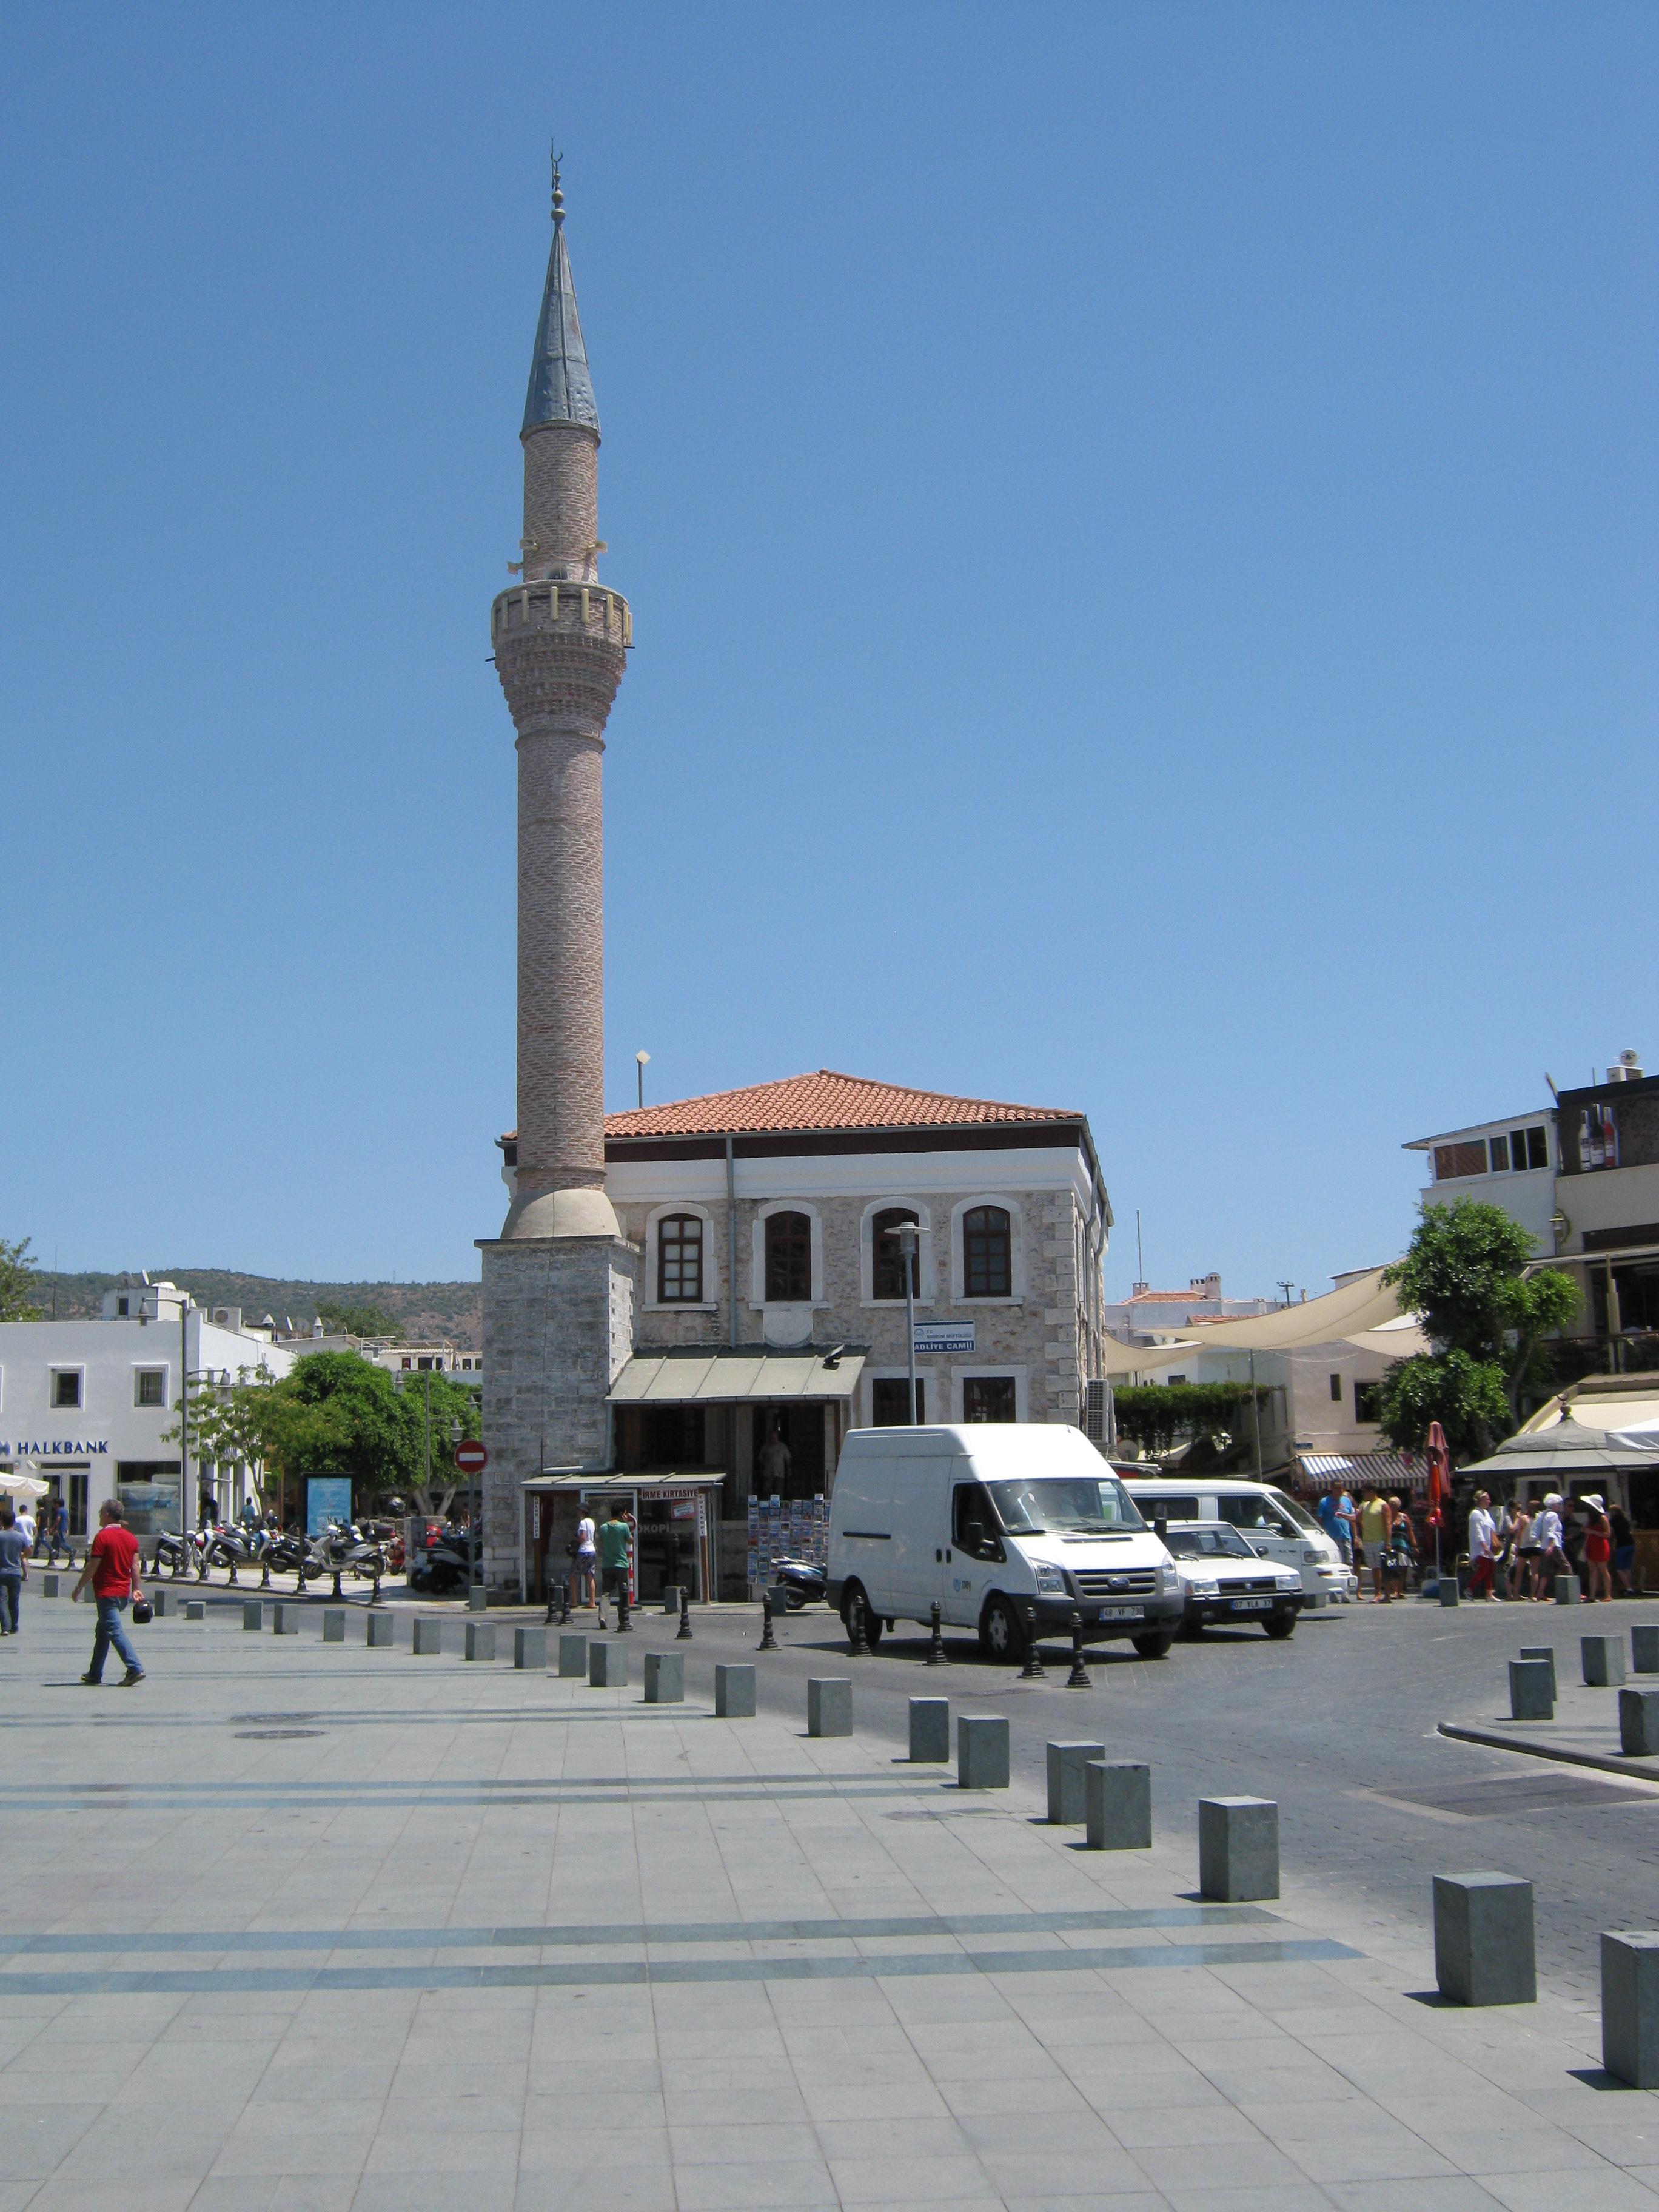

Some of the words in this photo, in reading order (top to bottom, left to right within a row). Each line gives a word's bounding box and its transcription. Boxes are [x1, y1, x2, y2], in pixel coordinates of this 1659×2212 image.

[947, 1341, 972, 1349] CAMİİ
[18, 1440, 108, 1455] HALKBANK
[663, 1487, 699, 1498] KIRTASİYE
[1105, 1608, 1113, 1617] 48
[1118, 1607, 1126, 1616] VF
